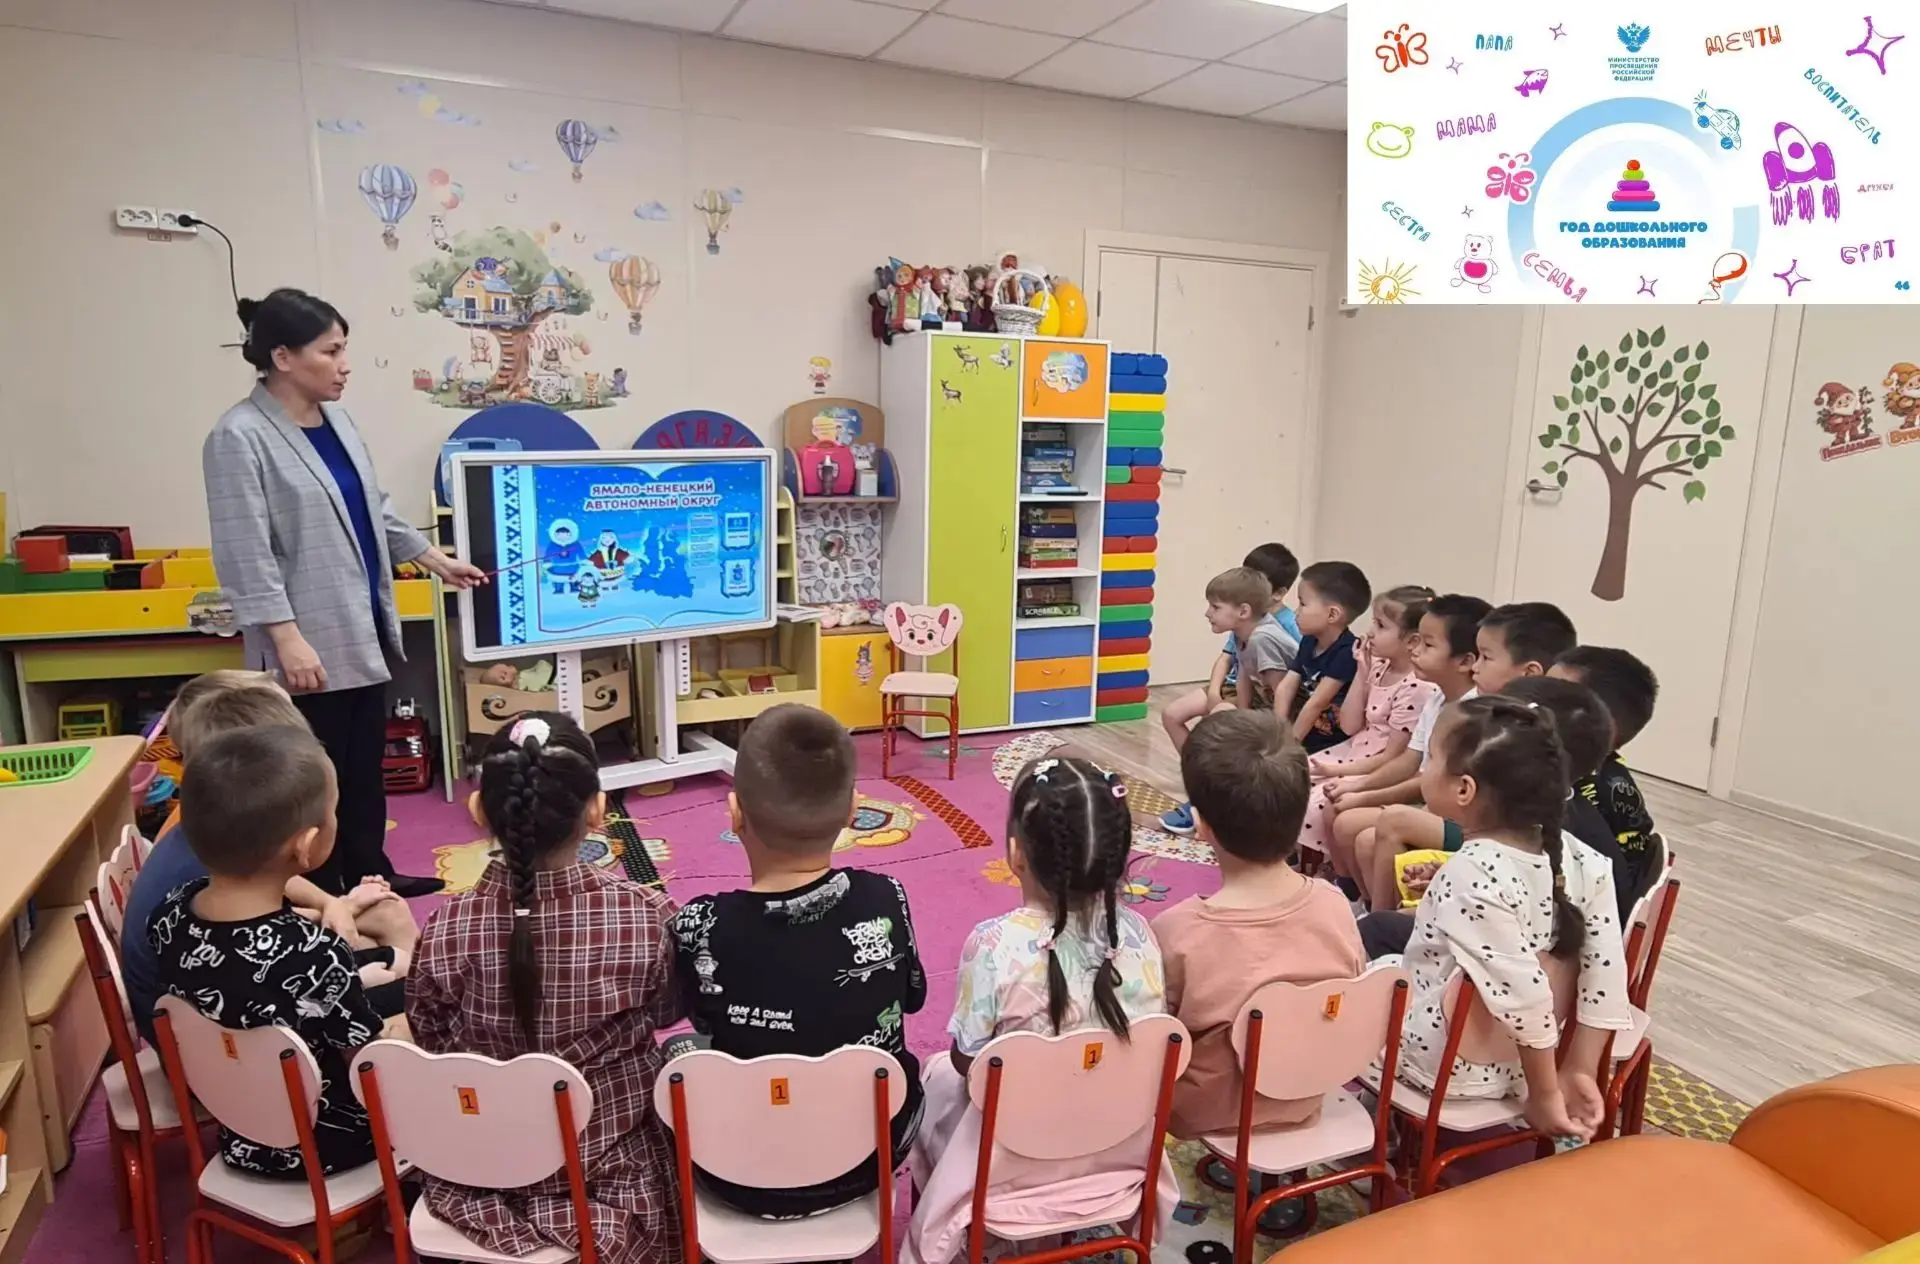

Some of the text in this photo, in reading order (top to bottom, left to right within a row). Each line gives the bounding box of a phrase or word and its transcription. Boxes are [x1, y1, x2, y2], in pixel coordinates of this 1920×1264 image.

[592, 480, 714, 495] ЯМАЛО-НЕНЕЦКИЙ
[585, 495, 720, 510] АВТОНОМНЫЙ ОКРУГ
[180, 952, 203, 970] UP
[192, 939, 225, 968] YOU
[1088, 1050, 1097, 1064] 1
[775, 1085, 787, 1100] 1
[462, 1094, 475, 1109] 1
